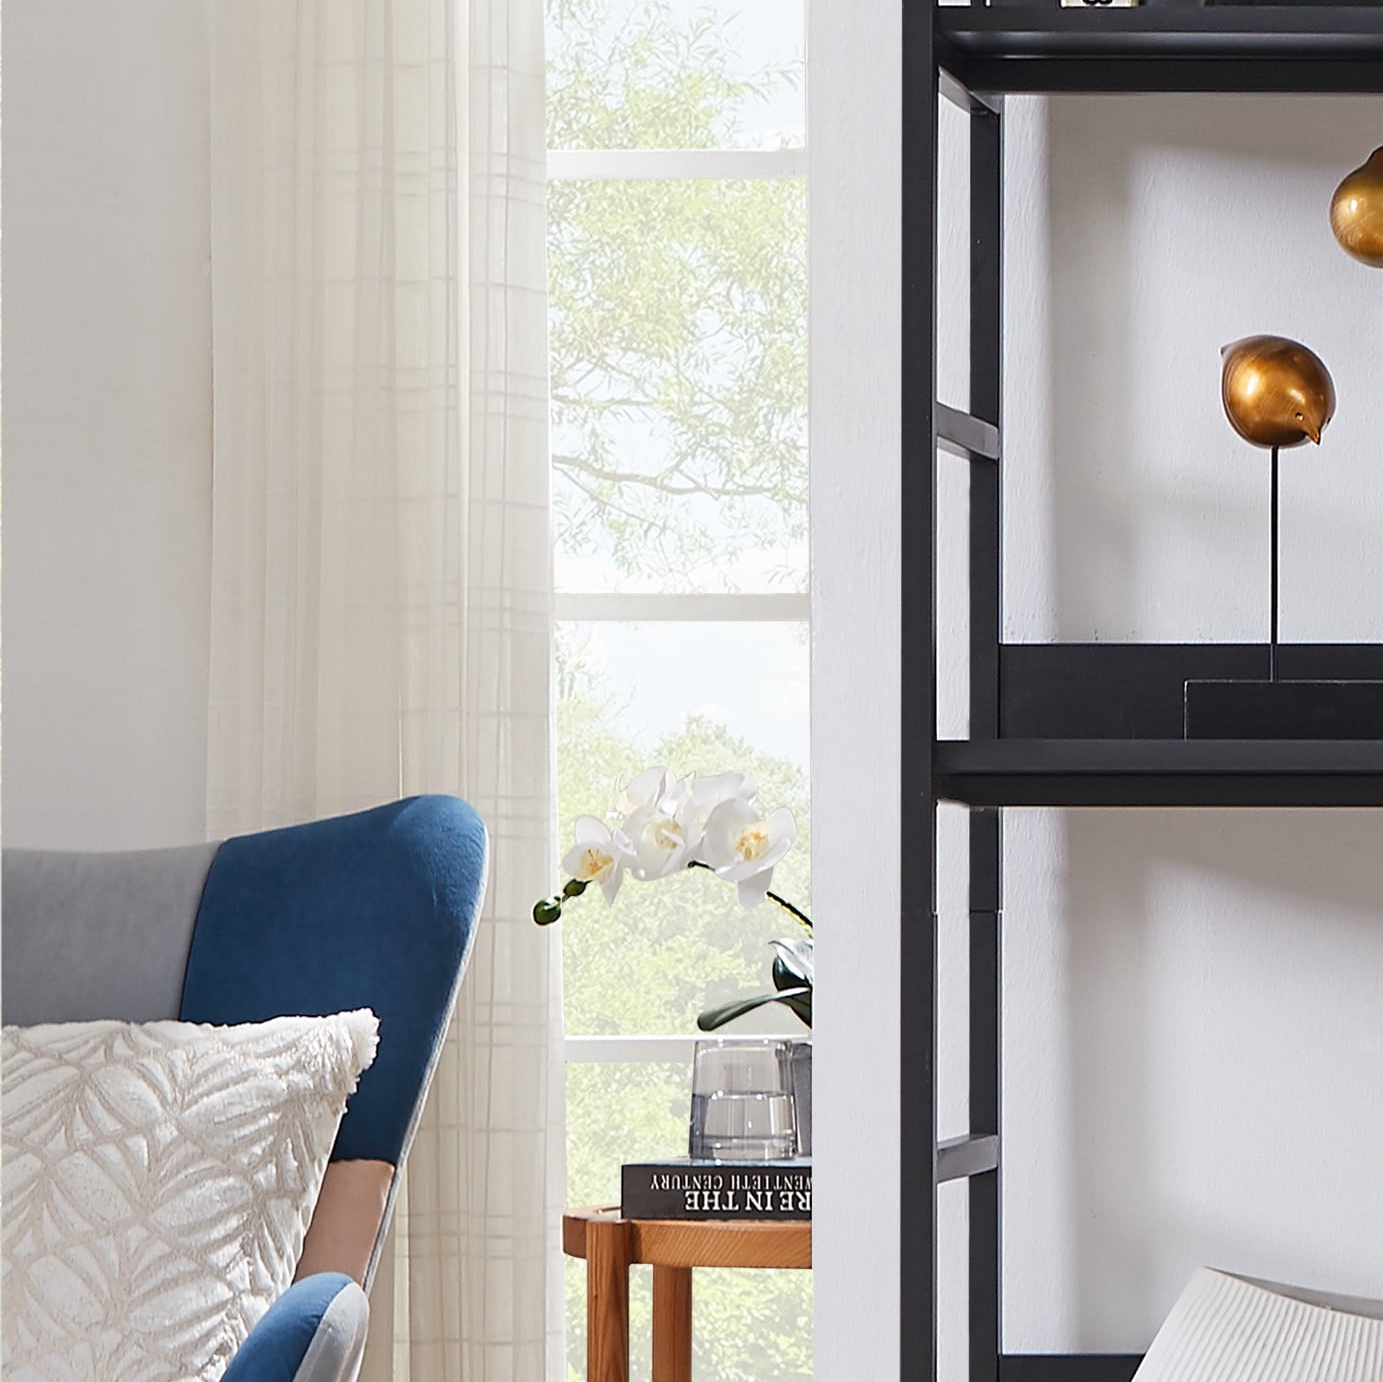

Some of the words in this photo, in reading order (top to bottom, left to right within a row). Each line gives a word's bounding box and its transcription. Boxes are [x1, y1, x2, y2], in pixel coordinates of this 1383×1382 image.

[650, 1174, 724, 1191] CENTURY
[684, 1191, 739, 1212] THE
[744, 1191, 773, 1212] IN
